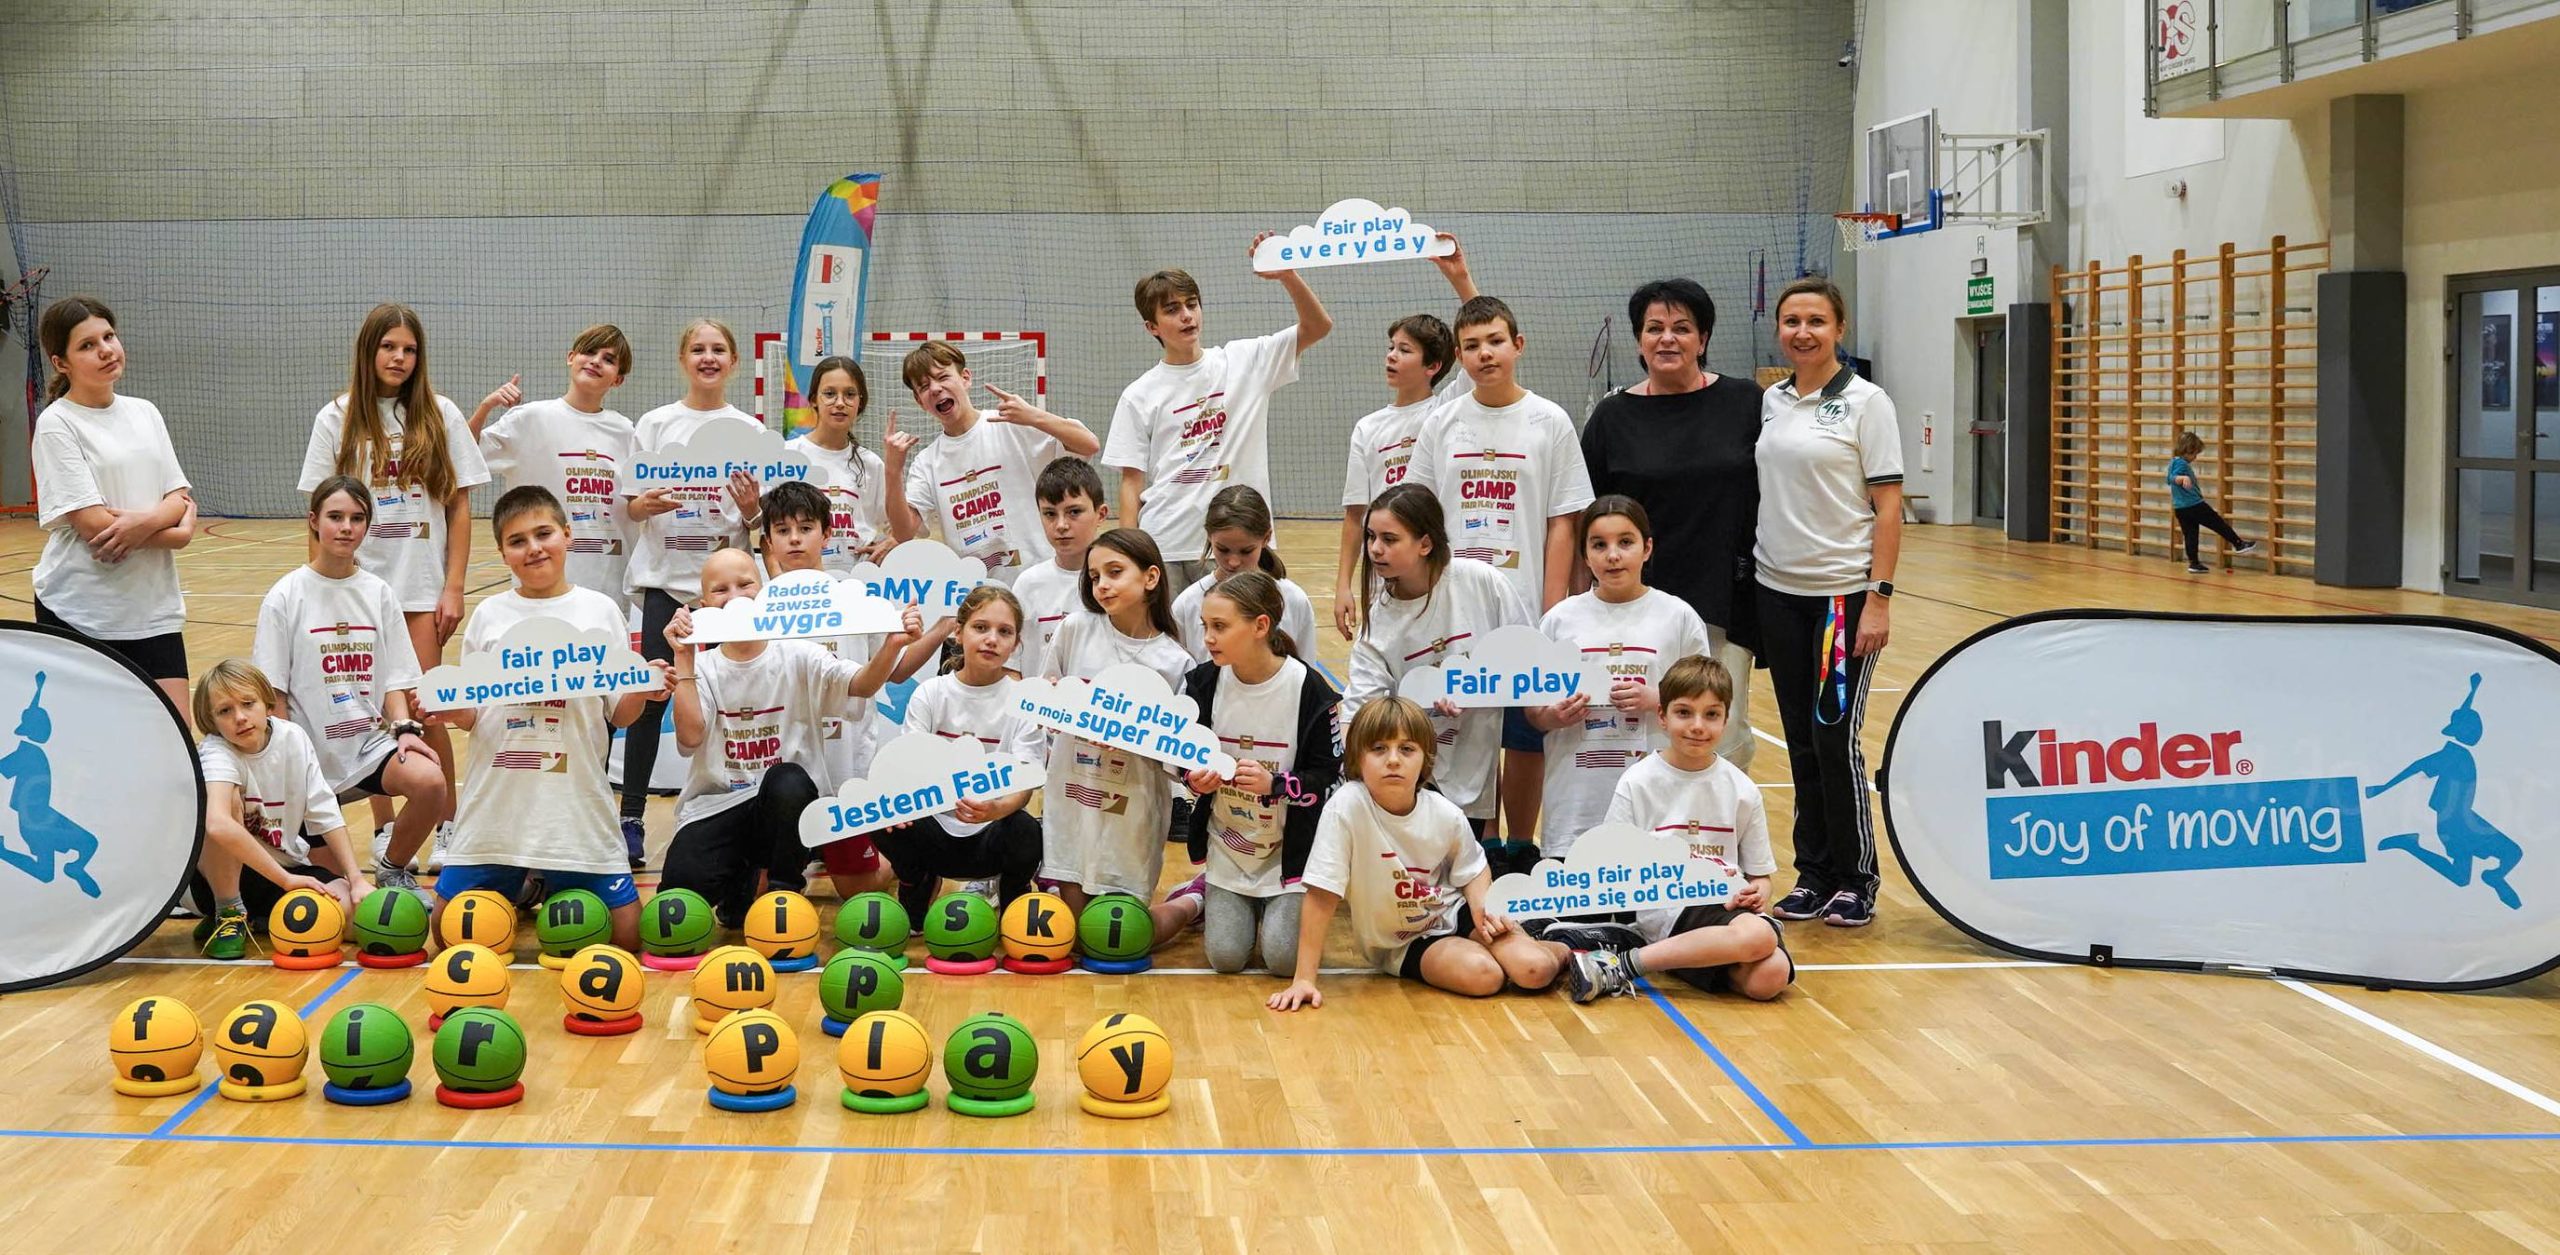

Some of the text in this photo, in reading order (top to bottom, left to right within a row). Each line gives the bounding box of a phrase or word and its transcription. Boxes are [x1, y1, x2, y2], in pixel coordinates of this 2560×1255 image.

[1323, 216, 1404, 236] Fair play
[635, 461, 717, 483] Drużyna
[764, 461, 808, 481] play
[1460, 469, 1517, 480] OLIMPIJSKI
[565, 477, 614, 495] CAMP
[949, 480, 999, 503] OLIMPIJSKI
[1461, 480, 1516, 500] CAMP
[952, 491, 1001, 520] CAMP
[768, 580, 830, 598] Radość
[766, 598, 832, 612] zawsze
[753, 610, 843, 635] wygra
[322, 653, 373, 673] CAMP
[501, 642, 607, 670] fair play
[437, 666, 650, 704] w sporcie i w życiu
[1446, 667, 1581, 699] Fair play
[1090, 687, 1189, 735] Fair play
[1020, 699, 1211, 765] to moja super moc
[725, 737, 781, 761] CAMP
[828, 762, 1014, 834] Jestem Fair
[2003, 810, 2089, 865] Joy
[2105, 804, 2154, 852] of
[2167, 797, 2343, 853] moving
[1546, 861, 1685, 891] Bieg fair play
[1507, 878, 1729, 916] zaczyna się od Ciebie
